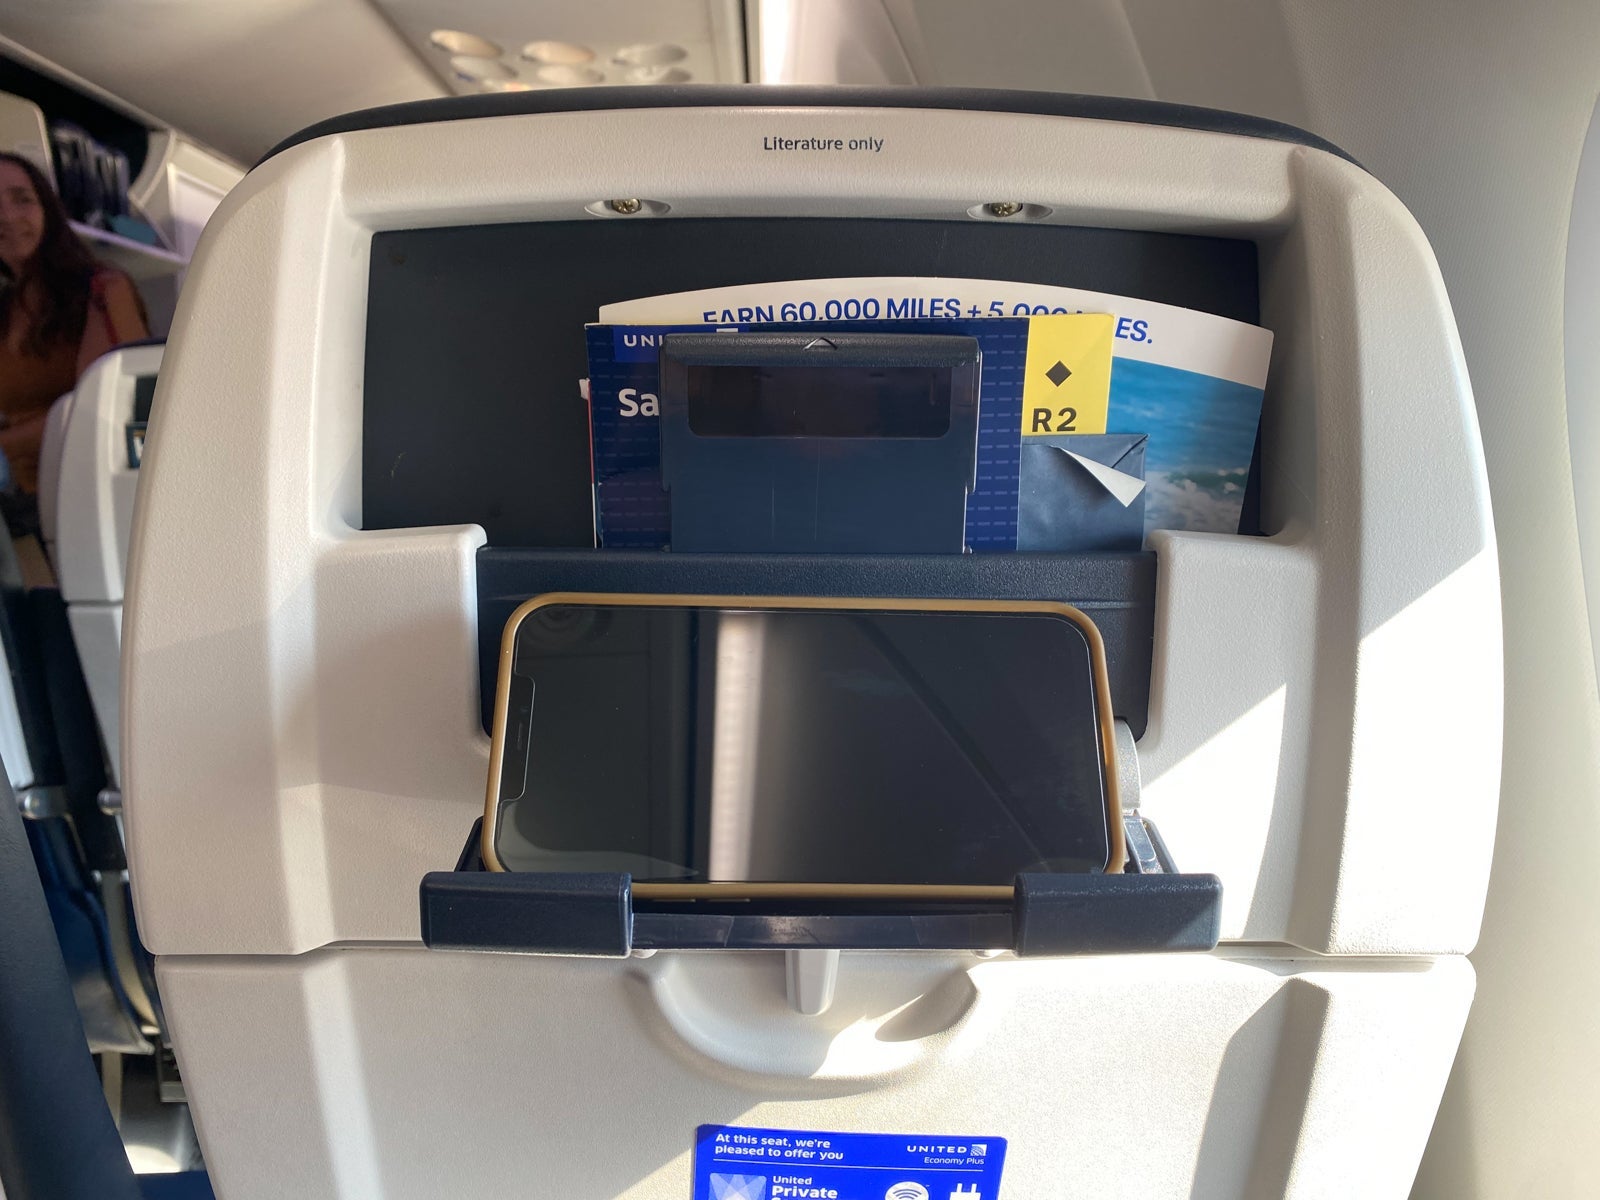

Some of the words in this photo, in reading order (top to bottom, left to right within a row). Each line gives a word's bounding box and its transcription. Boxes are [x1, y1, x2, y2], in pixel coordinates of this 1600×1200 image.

[763, 136, 844, 151] Literature
[848, 136, 884, 153] only
[703, 304, 774, 323] EARN
[886, 297, 961, 319] MILES
[1031, 406, 1077, 433] R2
[715, 1133, 731, 1143] At
[733, 1134, 758, 1145] this
[761, 1136, 792, 1147] seat,
[795, 1139, 831, 1148] we're
[715, 1145, 765, 1156] pleased
[768, 1148, 781, 1157] to
[784, 1148, 816, 1158] offer
[820, 1152, 844, 1161] you
[906, 1145, 967, 1153] UNITED
[923, 1156, 965, 1166] Economy
[966, 1157, 985, 1165] Plus
[773, 1175, 812, 1185] United
[772, 1185, 838, 1199] Private
